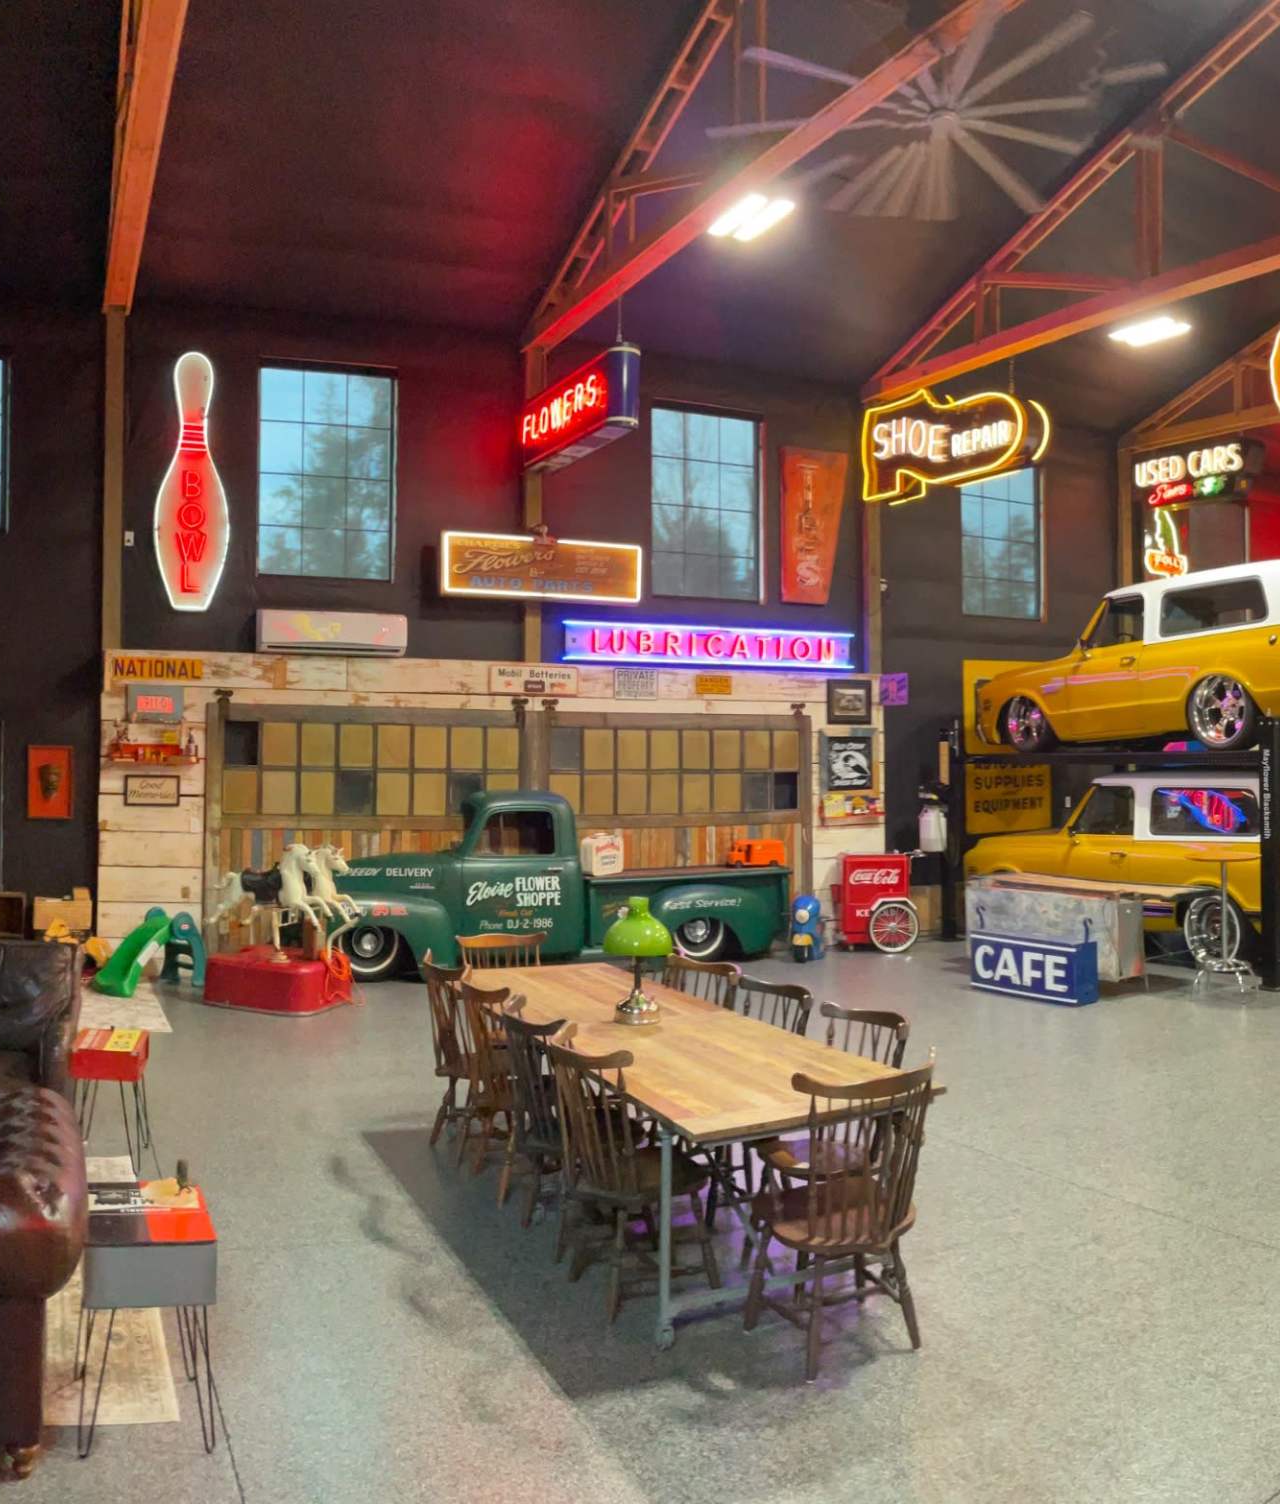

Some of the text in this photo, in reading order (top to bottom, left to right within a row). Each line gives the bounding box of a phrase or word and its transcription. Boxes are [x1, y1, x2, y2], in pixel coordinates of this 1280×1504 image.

[522, 374, 598, 445] FLOWERS
[873, 416, 1011, 463] SHOE REPAIR
[1135, 455, 1186, 488] USED
[1187, 443, 1244, 478] CARS
[175, 470, 208, 593] BOWL
[455, 549, 554, 574] Flowers
[471, 576, 593, 593] AUTO PARTS
[590, 627, 836, 663] LUBRICATION
[113, 657, 203, 680] NATIONAL
[529, 669, 572, 681] Batteries
[974, 774, 1045, 791] SUPPLIES
[1262, 748, 1272, 840] Mayflower Blacksmith
[974, 796, 1043, 814] EQUIPMENT
[386, 867, 434, 878] DELIVERY
[466, 875, 561, 906] Eloise FLOWER
[516, 891, 561, 907] SHOPPE
[662, 899, 691, 911] Fast
[855, 909, 870, 918] ICE
[479, 918, 553, 930] Phone DJ-2-1986
[974, 944, 1069, 993] CAFE
